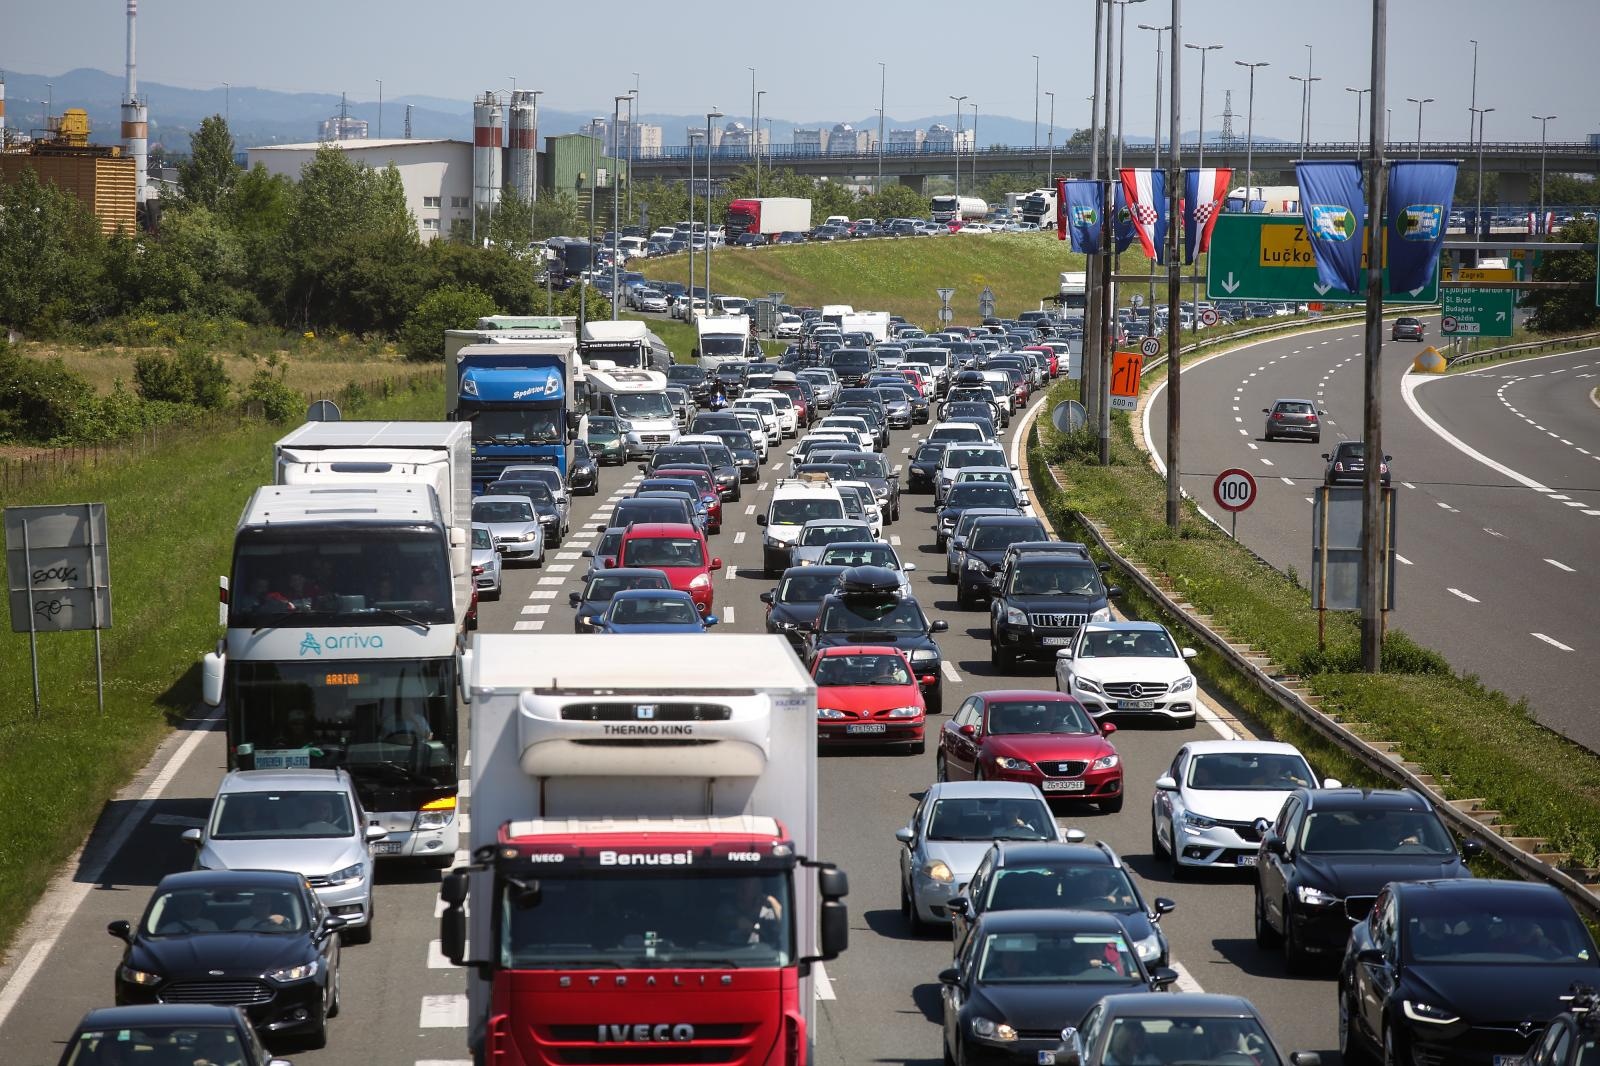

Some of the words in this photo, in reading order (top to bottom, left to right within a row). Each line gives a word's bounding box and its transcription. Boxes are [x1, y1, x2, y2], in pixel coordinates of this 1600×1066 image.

[1263, 248, 1316, 262] Lučko
[1144, 341, 1157, 353] 80
[1112, 398, 1126, 406] 600
[1221, 481, 1249, 500] 100
[324, 632, 383, 649] arriva
[603, 724, 659, 735] THERMO
[661, 724, 693, 735] KING
[531, 853, 565, 863] IVECO
[599, 850, 693, 865] Benussi
[727, 851, 761, 862] IVECO
[559, 974, 732, 987] STRALIS
[597, 1023, 695, 1043] IVECO
